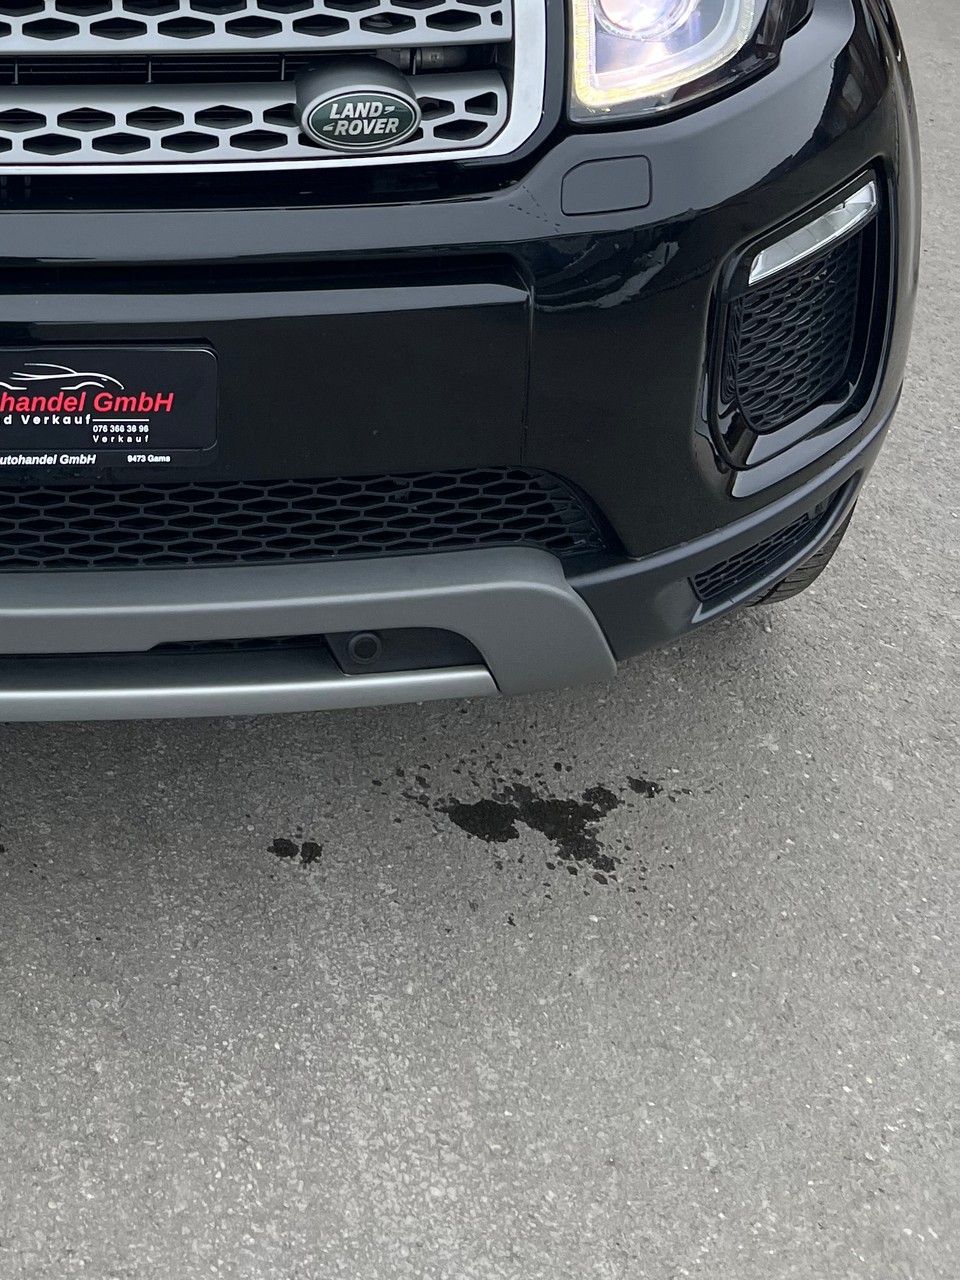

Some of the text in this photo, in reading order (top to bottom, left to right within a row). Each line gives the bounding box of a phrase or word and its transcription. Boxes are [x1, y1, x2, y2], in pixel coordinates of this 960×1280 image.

[329, 102, 383, 119] LAND
[334, 118, 399, 135] ROVER
[93, 391, 175, 413] GmbH
[20, 413, 91, 425] Verkauf
[92, 434, 149, 443] Verkauf
[60, 454, 97, 465] GmbH
[127, 454, 171, 463] 9473 Gams
